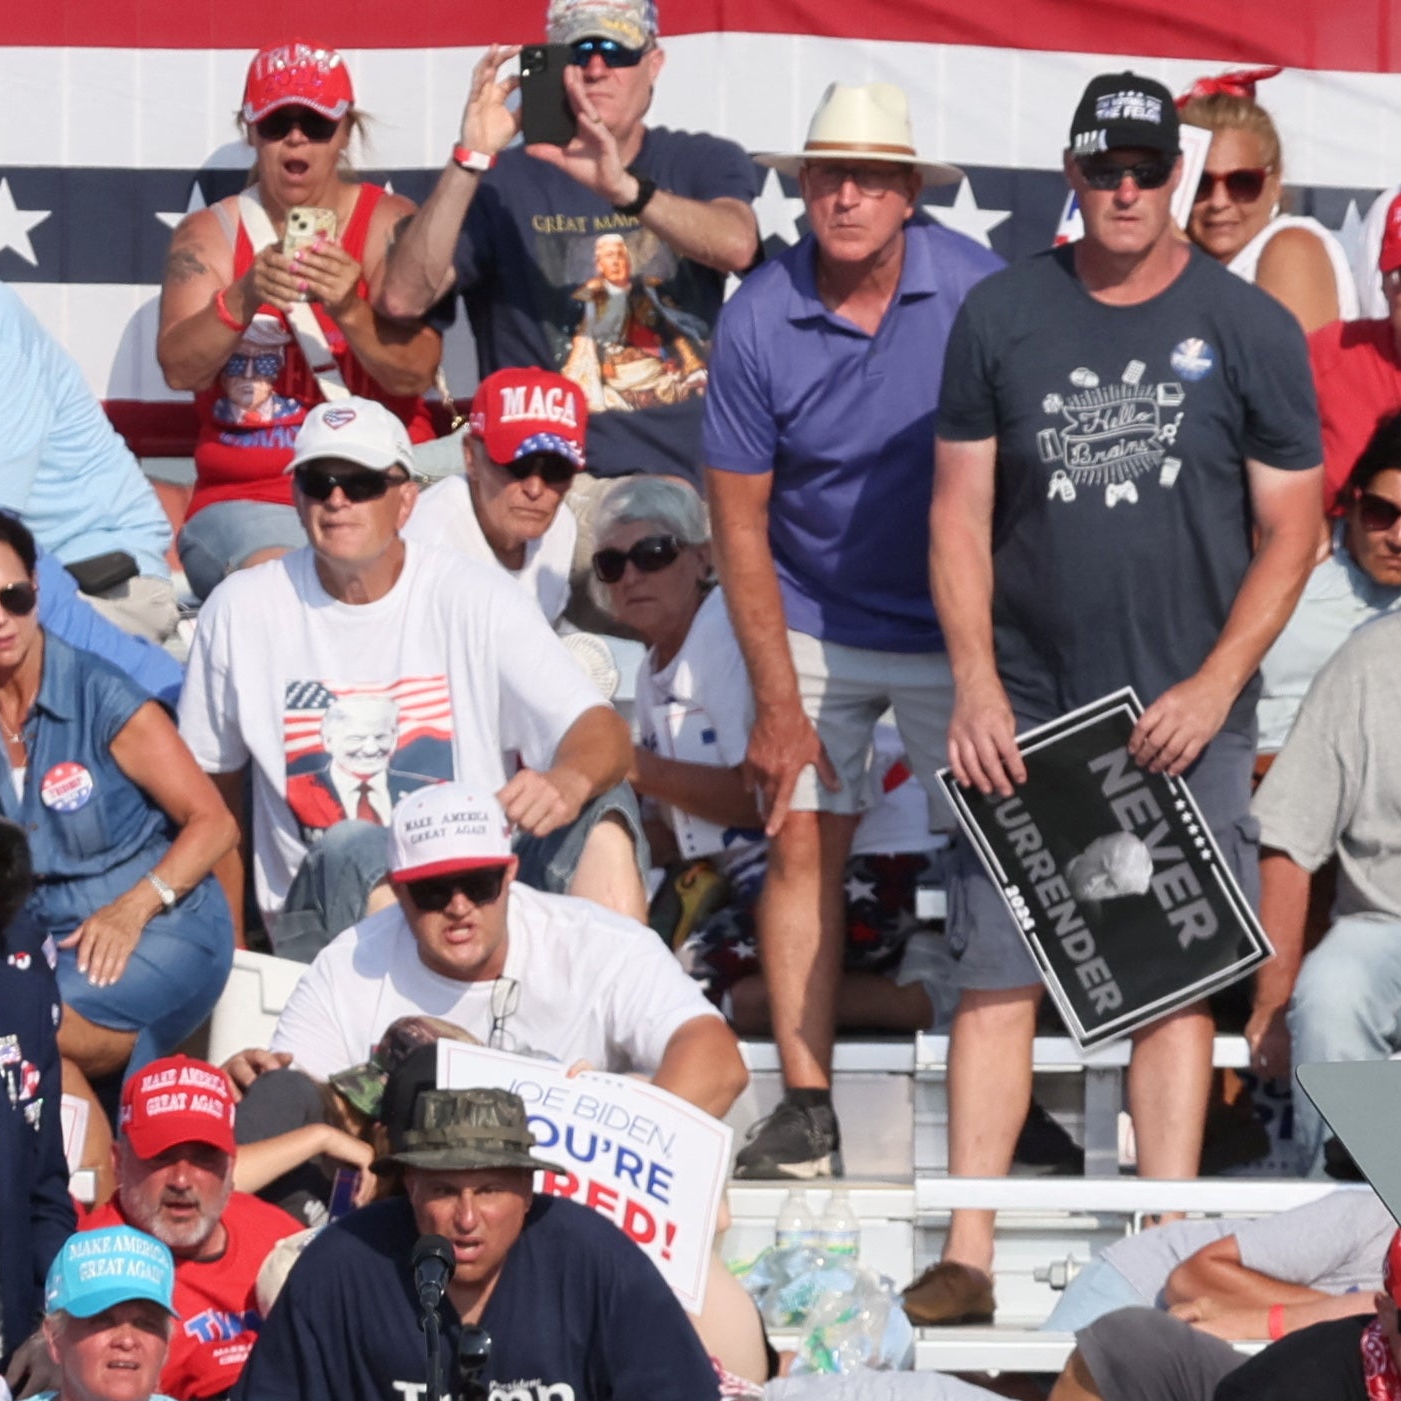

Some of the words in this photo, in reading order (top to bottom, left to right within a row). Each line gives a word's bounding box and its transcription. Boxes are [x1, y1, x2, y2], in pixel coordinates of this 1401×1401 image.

[532, 213, 587, 234] GREAT
[499, 385, 577, 428] MAGA
[1078, 403, 1154, 434] Hello
[404, 817, 435, 832] MAKE
[441, 811, 489, 825] AMERICA
[410, 827, 447, 845] GREAT
[454, 824, 488, 837] AGAIN
[1088, 745, 1220, 948] NEVER
[1004, 882, 1038, 935] 2024
[141, 1070, 175, 1094] MAKE
[178, 1068, 228, 1098] AMERICA
[145, 1093, 188, 1117] GREAT
[189, 1094, 224, 1118] AGAIN
[509, 1078, 555, 1114] JOE
[560, 1094, 678, 1160] BIDEN,
[529, 1114, 675, 1205] OU'RE
[69, 1241, 111, 1261] MAKE
[113, 1236, 170, 1265] AMERICA
[78, 1261, 121, 1282] GREAT
[124, 1261, 164, 1283] AGAIN
